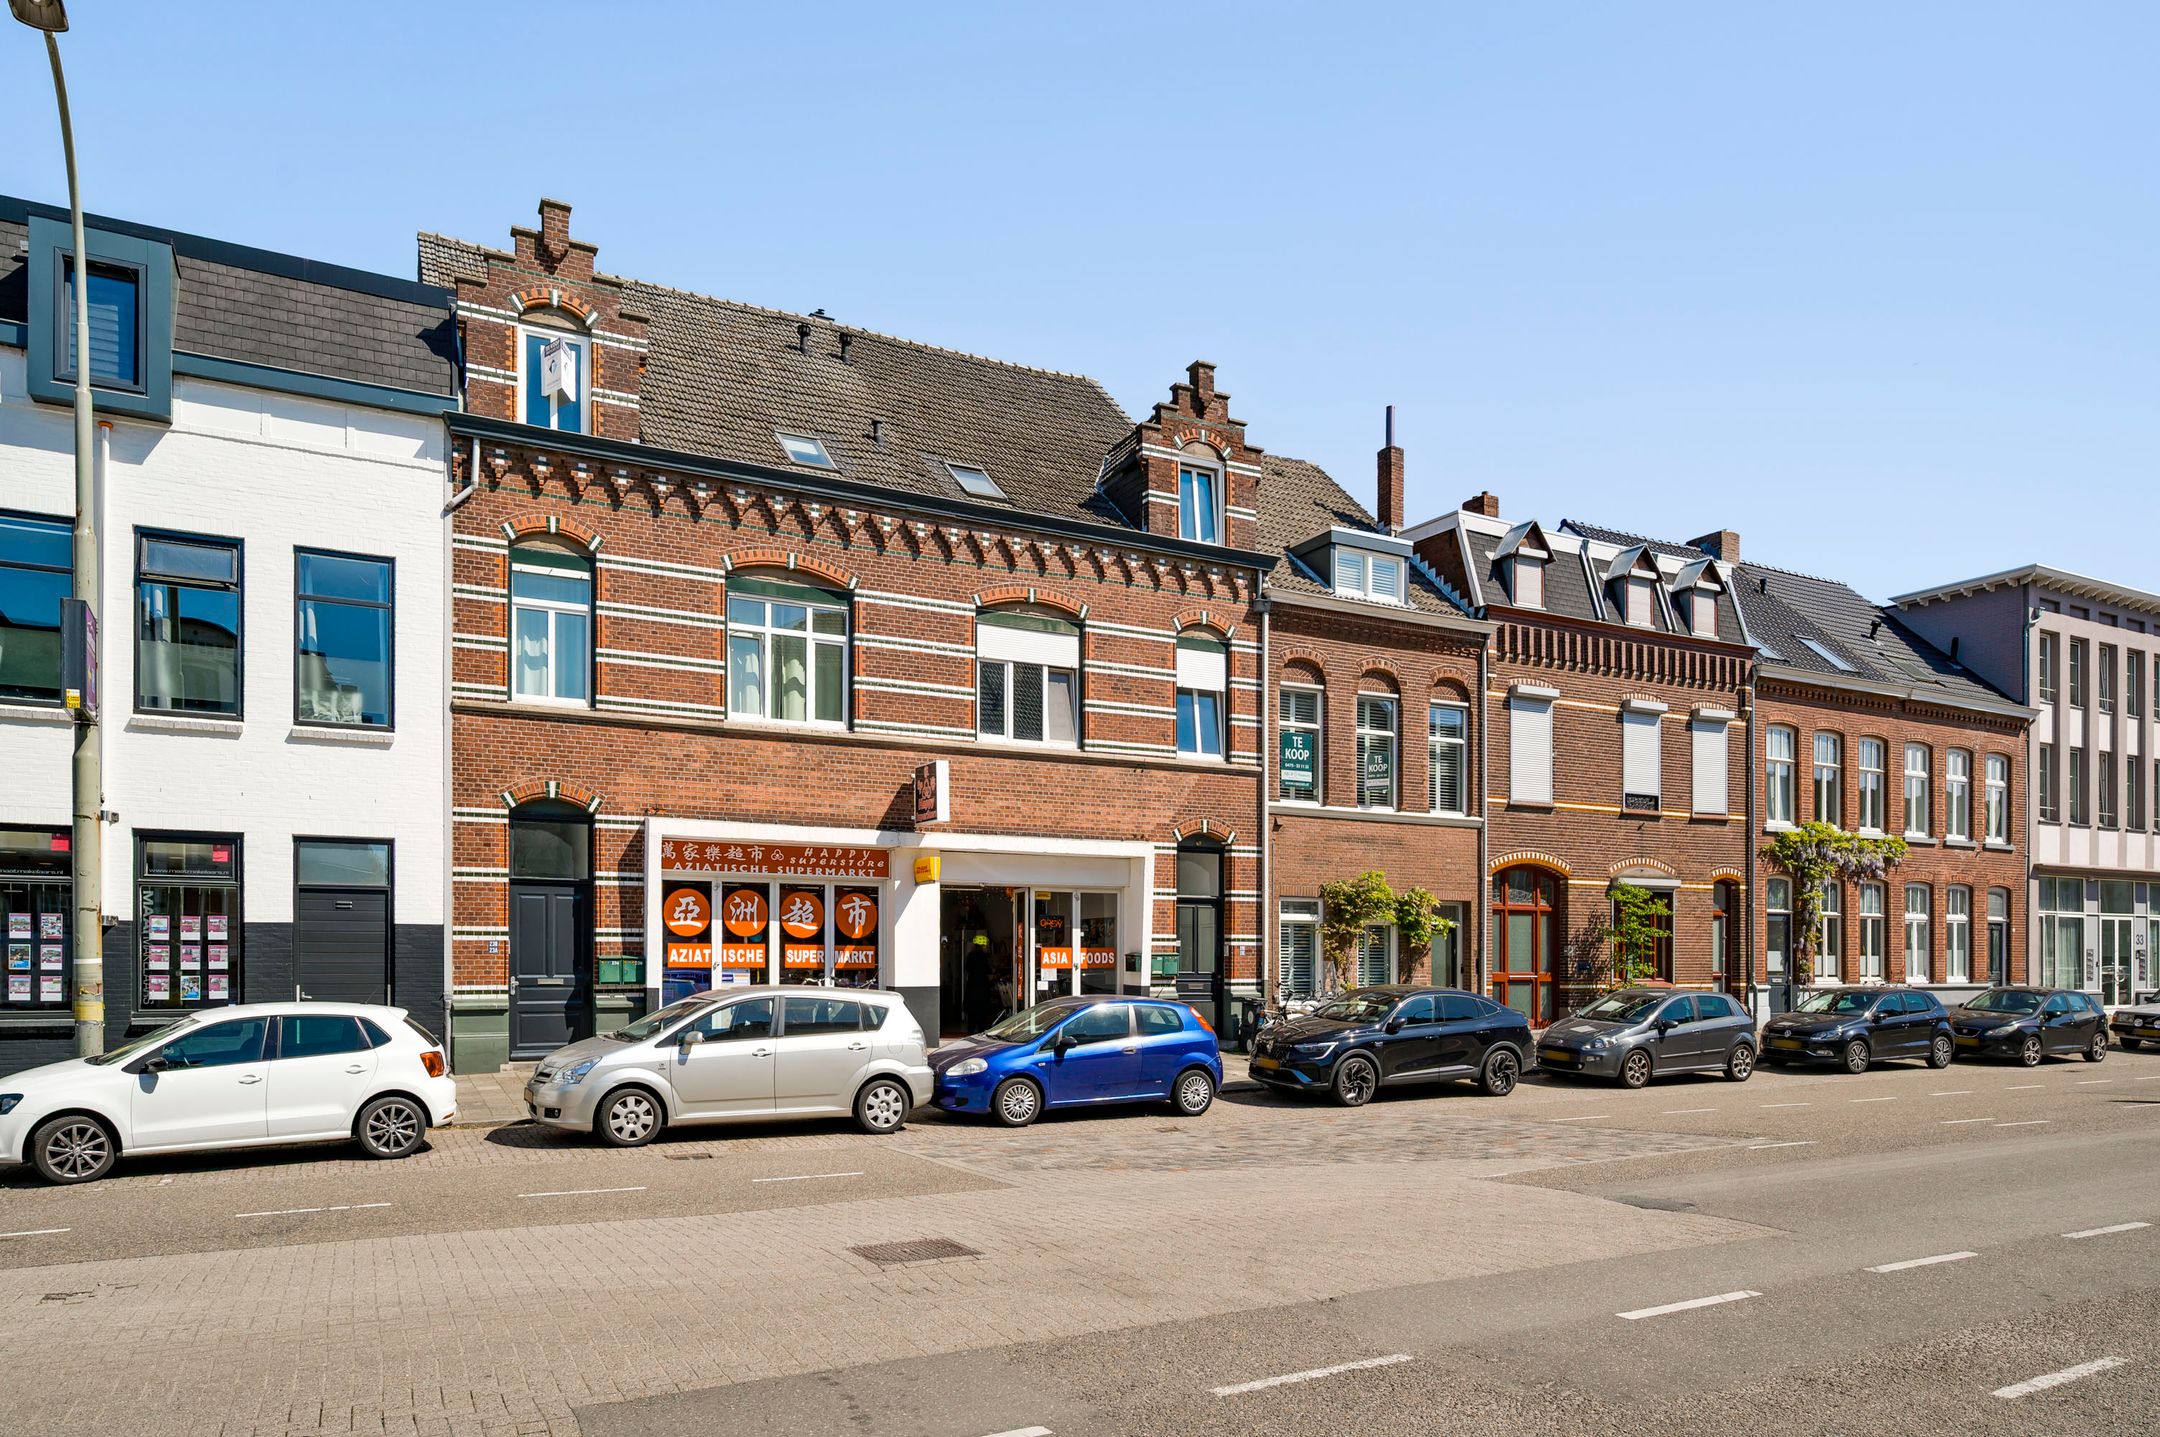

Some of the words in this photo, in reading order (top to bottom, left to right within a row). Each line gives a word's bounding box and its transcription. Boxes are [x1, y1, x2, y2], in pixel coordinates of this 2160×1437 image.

[1292, 736, 1303, 748] TE
[1285, 748, 1310, 760] KOOP
[1374, 755, 1382, 763] TE
[1368, 763, 1388, 772] KOOP
[662, 841, 765, 864] 萬家樂超市
[673, 862, 769, 874] AZIATISCHE
[777, 866, 875, 878] SUPERMARKT
[2136, 934, 2144, 945] 33
[669, 949, 764, 963] AZIATISCHE
[786, 949, 874, 964] SUPERMARKT
[1042, 952, 1068, 964] ASIA
[1080, 952, 1115, 964] FOODS
